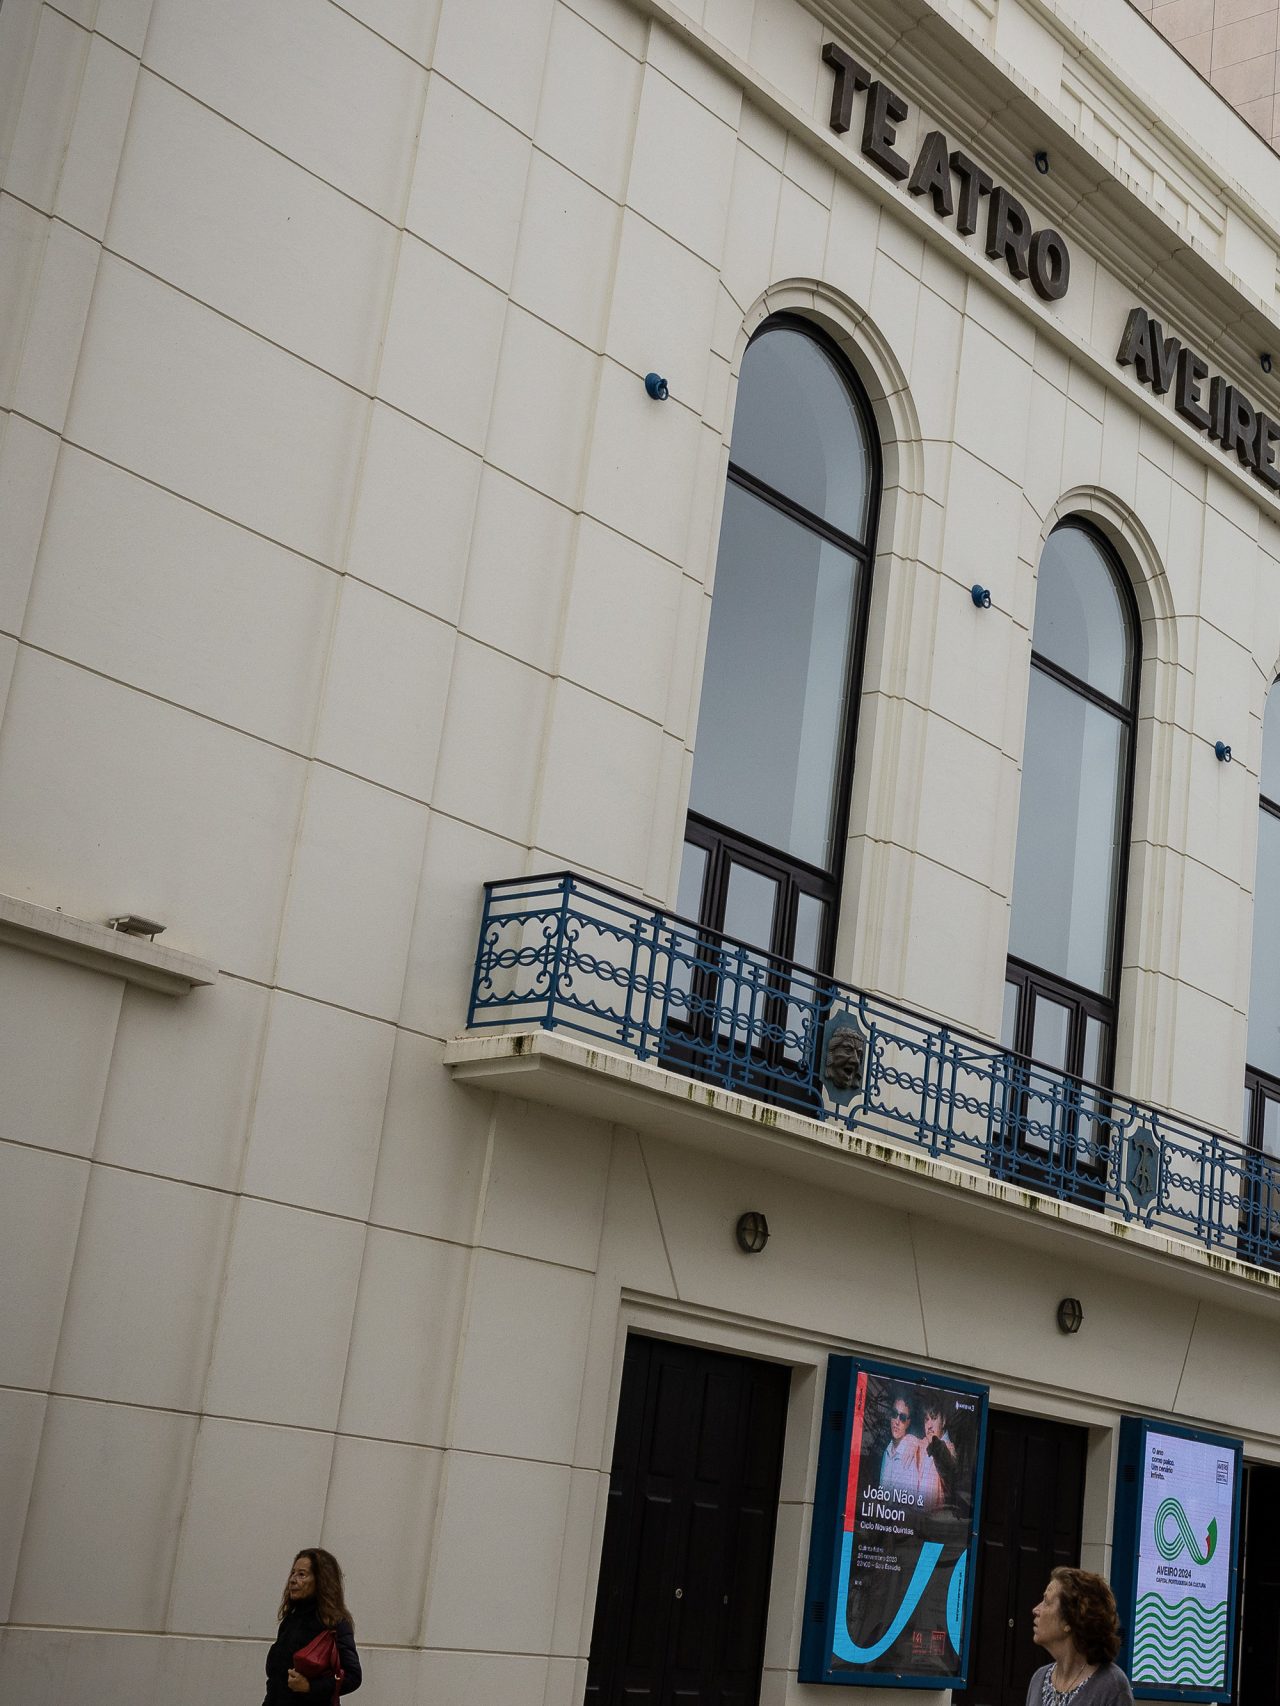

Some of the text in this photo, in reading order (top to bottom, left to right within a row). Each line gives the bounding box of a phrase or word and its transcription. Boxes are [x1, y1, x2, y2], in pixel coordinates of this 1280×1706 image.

[822, 42, 1071, 301] TEATRO
[1151, 1447, 1157, 1455] O
[864, 1485, 924, 1506] João Não &
[862, 1502, 905, 1521] Lil Noon
[860, 1520, 914, 1535] Ciclo Novas Quintas
[1156, 1565, 1192, 1579] AVEIRO 2024
